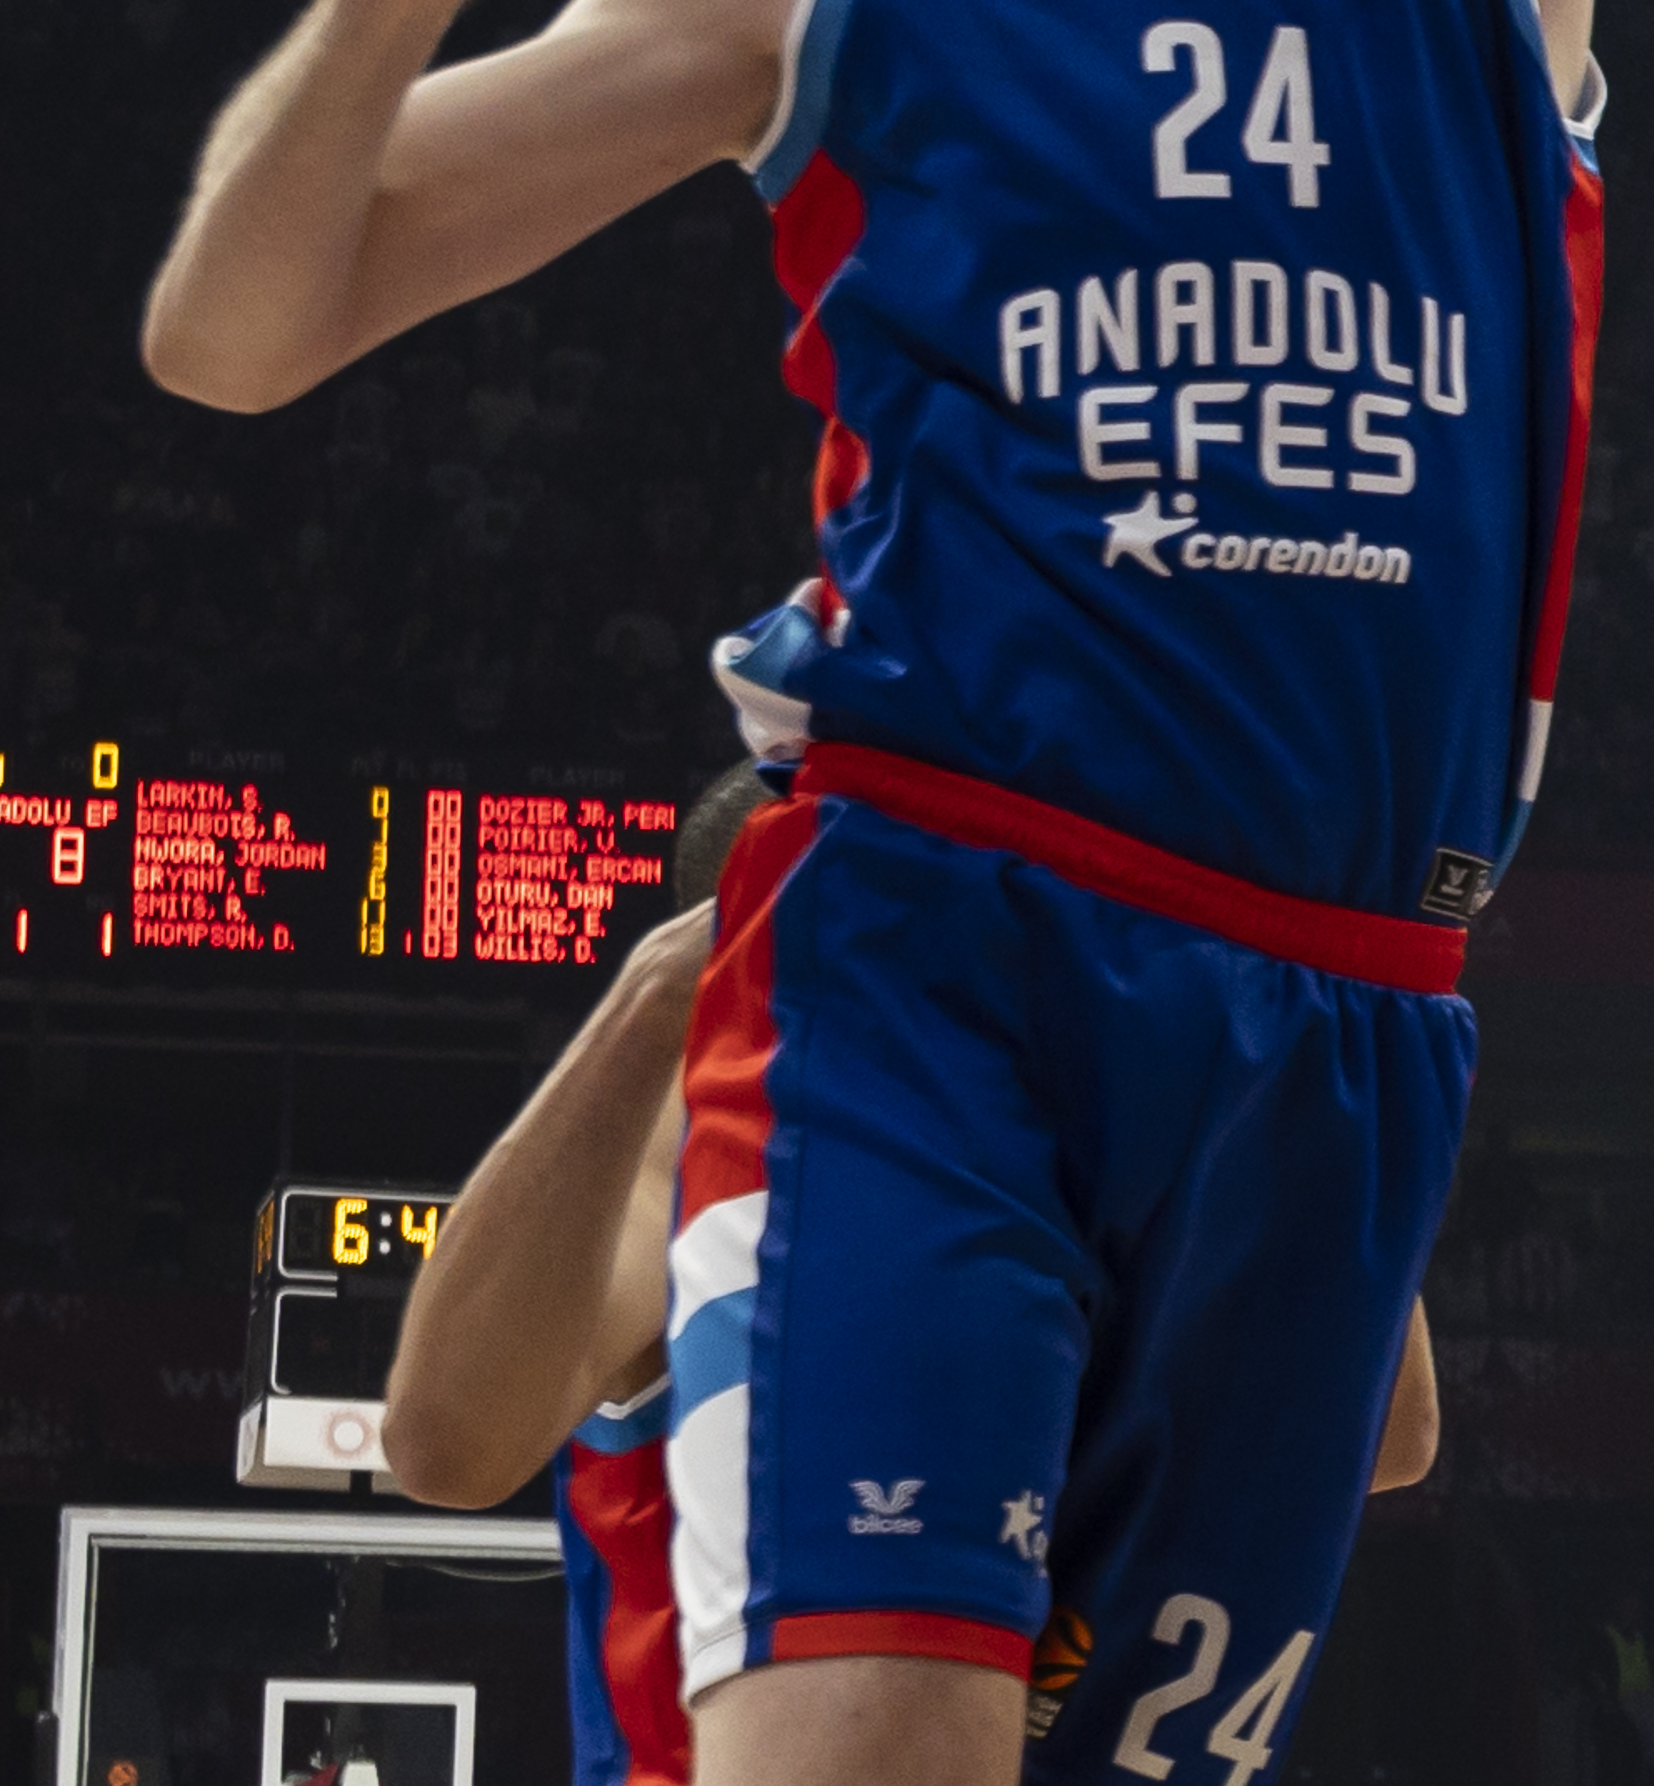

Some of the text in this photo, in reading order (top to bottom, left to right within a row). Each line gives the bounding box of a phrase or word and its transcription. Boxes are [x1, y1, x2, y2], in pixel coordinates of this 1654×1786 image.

[1140, 21, 1331, 208] 24
[1000, 260, 1467, 415] ANADOLU
[1077, 383, 1416, 495] EFES
[1180, 530, 1412, 585] corendon
[479, 793, 568, 825] DOZIER
[52, 827, 85, 885] 8
[235, 841, 326, 870] JORDAN
[1113, 1593, 1315, 1786] 24
